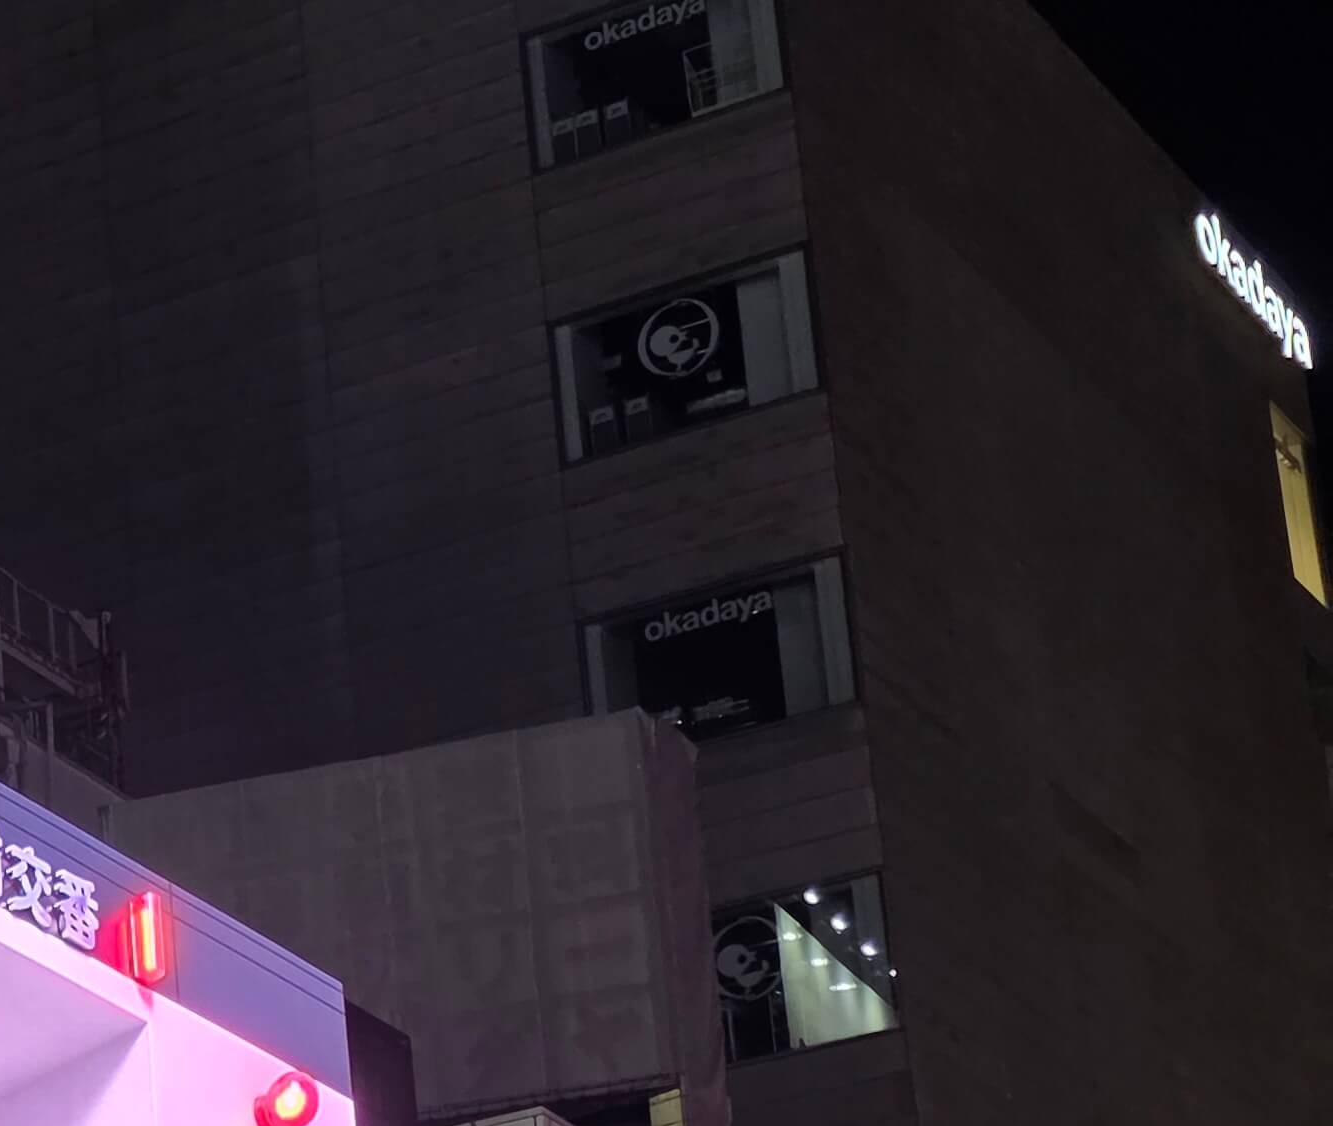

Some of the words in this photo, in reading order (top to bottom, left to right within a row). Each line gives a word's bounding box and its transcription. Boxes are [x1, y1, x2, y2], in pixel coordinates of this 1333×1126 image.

[583, 0, 707, 52] okadaya
[1193, 212, 1315, 370] okadaya
[644, 588, 774, 643] okadaya
